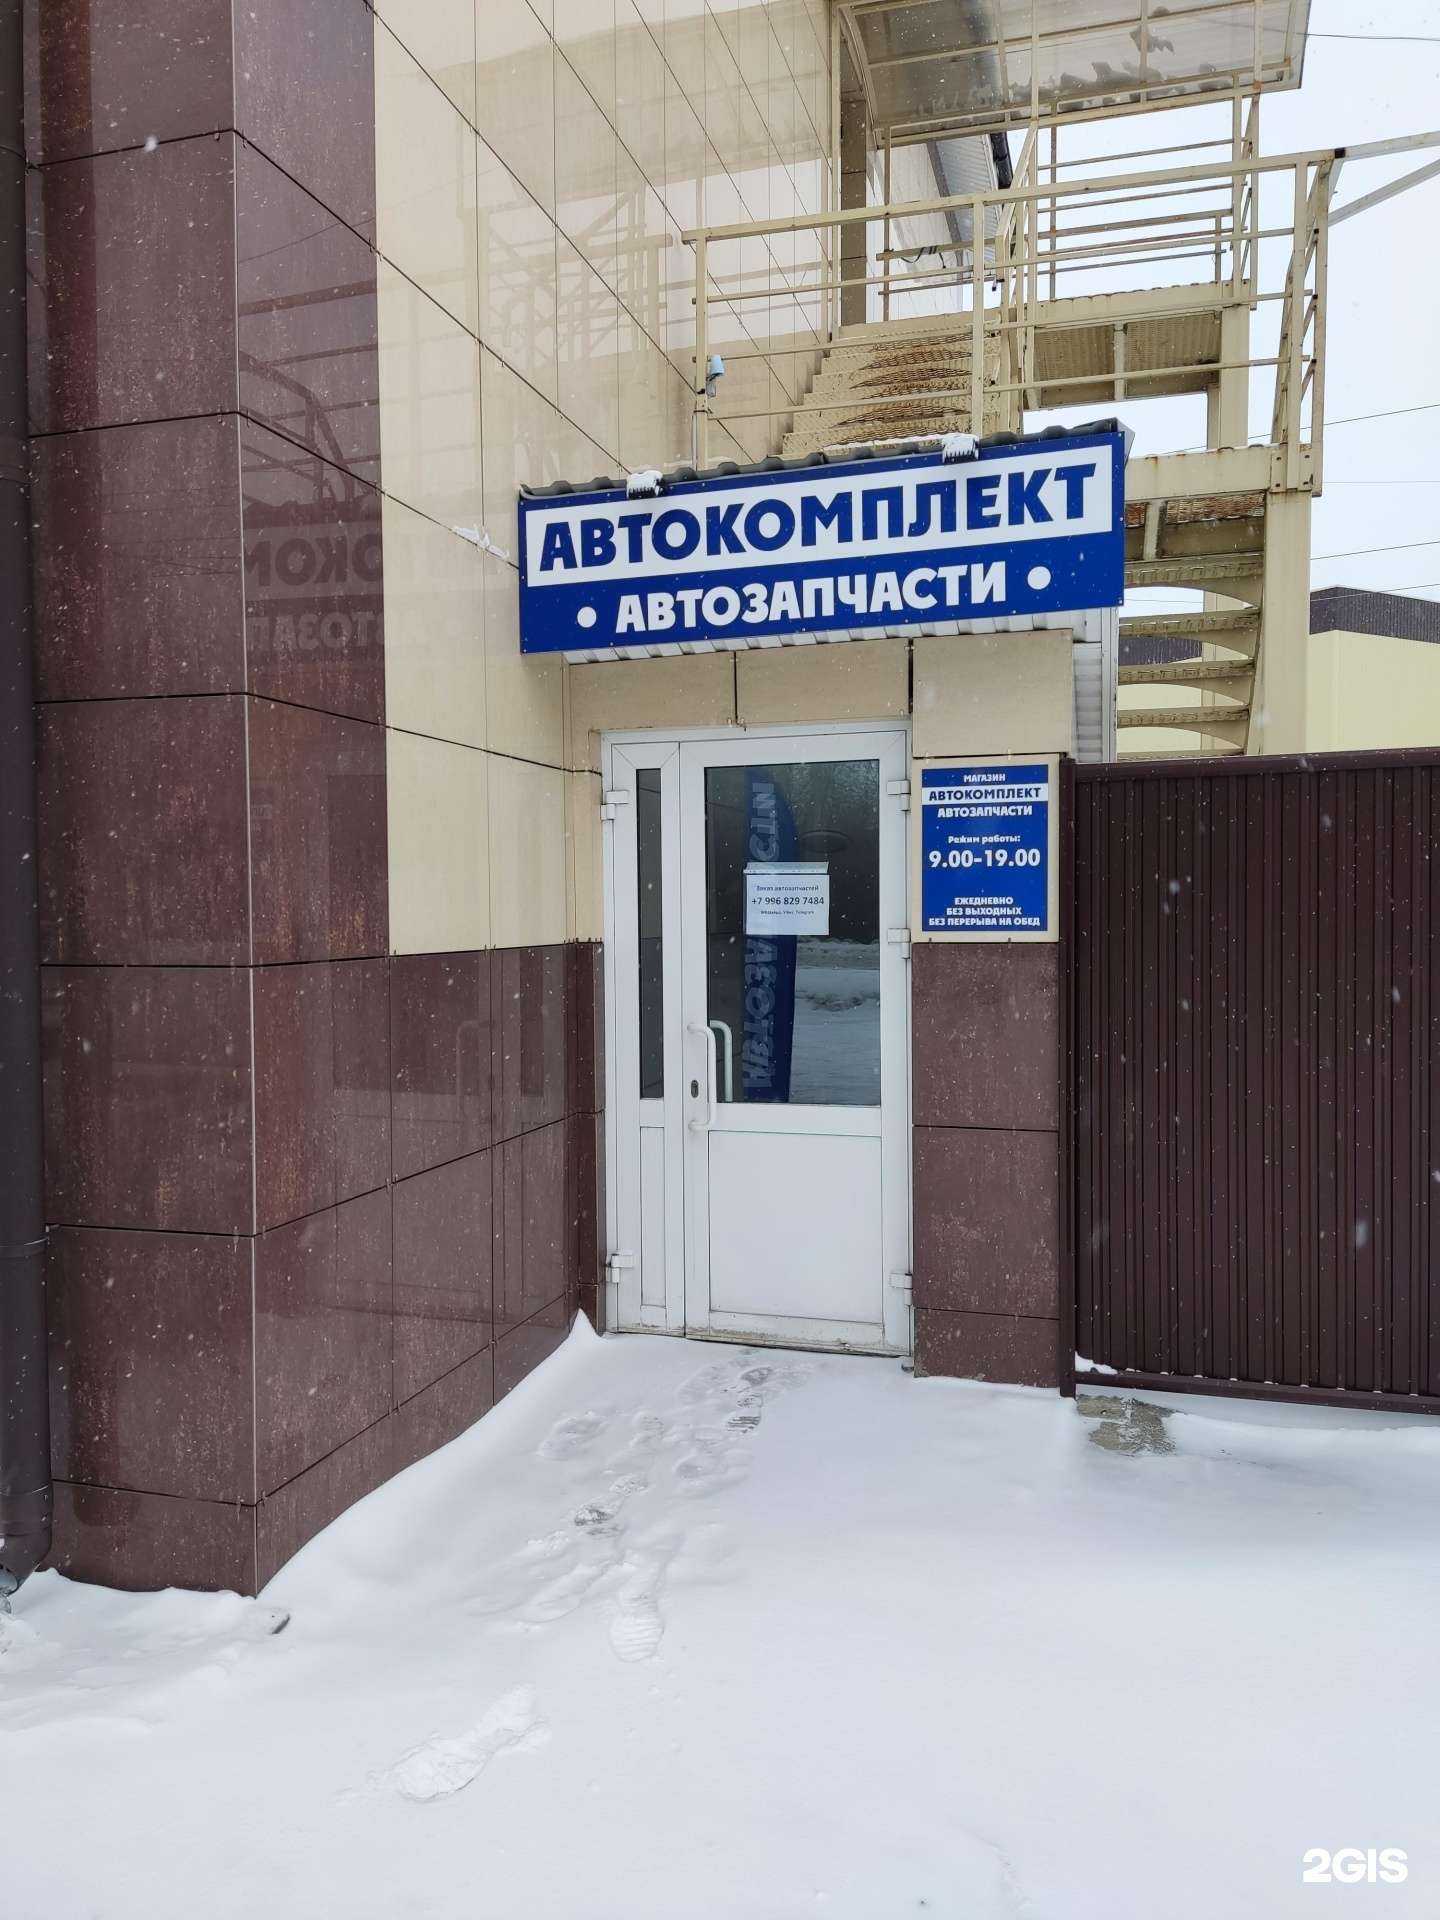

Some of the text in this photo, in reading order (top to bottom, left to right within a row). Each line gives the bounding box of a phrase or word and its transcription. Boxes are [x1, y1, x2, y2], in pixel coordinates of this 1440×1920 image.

[539, 462, 1097, 572] АВТОКОМПЛЕКТ
[616, 561, 1006, 633] АВТОЗАПЧАСТИ
[963, 773, 1006, 783] МАГАЗИН
[929, 787, 1041, 801] АВТОКОМПЛЕКТ
[937, 806, 1033, 818] АВТОЗАПЧАСТИ
[948, 834, 1021, 845] Режим работы:
[928, 848, 1041, 868] 9.00-19.00
[751, 896, 825, 905] +7 996 829 7484
[954, 897, 1014, 905] ЕЖЕДНЕВНО
[946, 907, 1022, 916] БЕЗ ВЫХОДНЫХ
[928, 917, 1041, 926] БЕЗ ПЕРЕРЫВА НА ОБЕД
